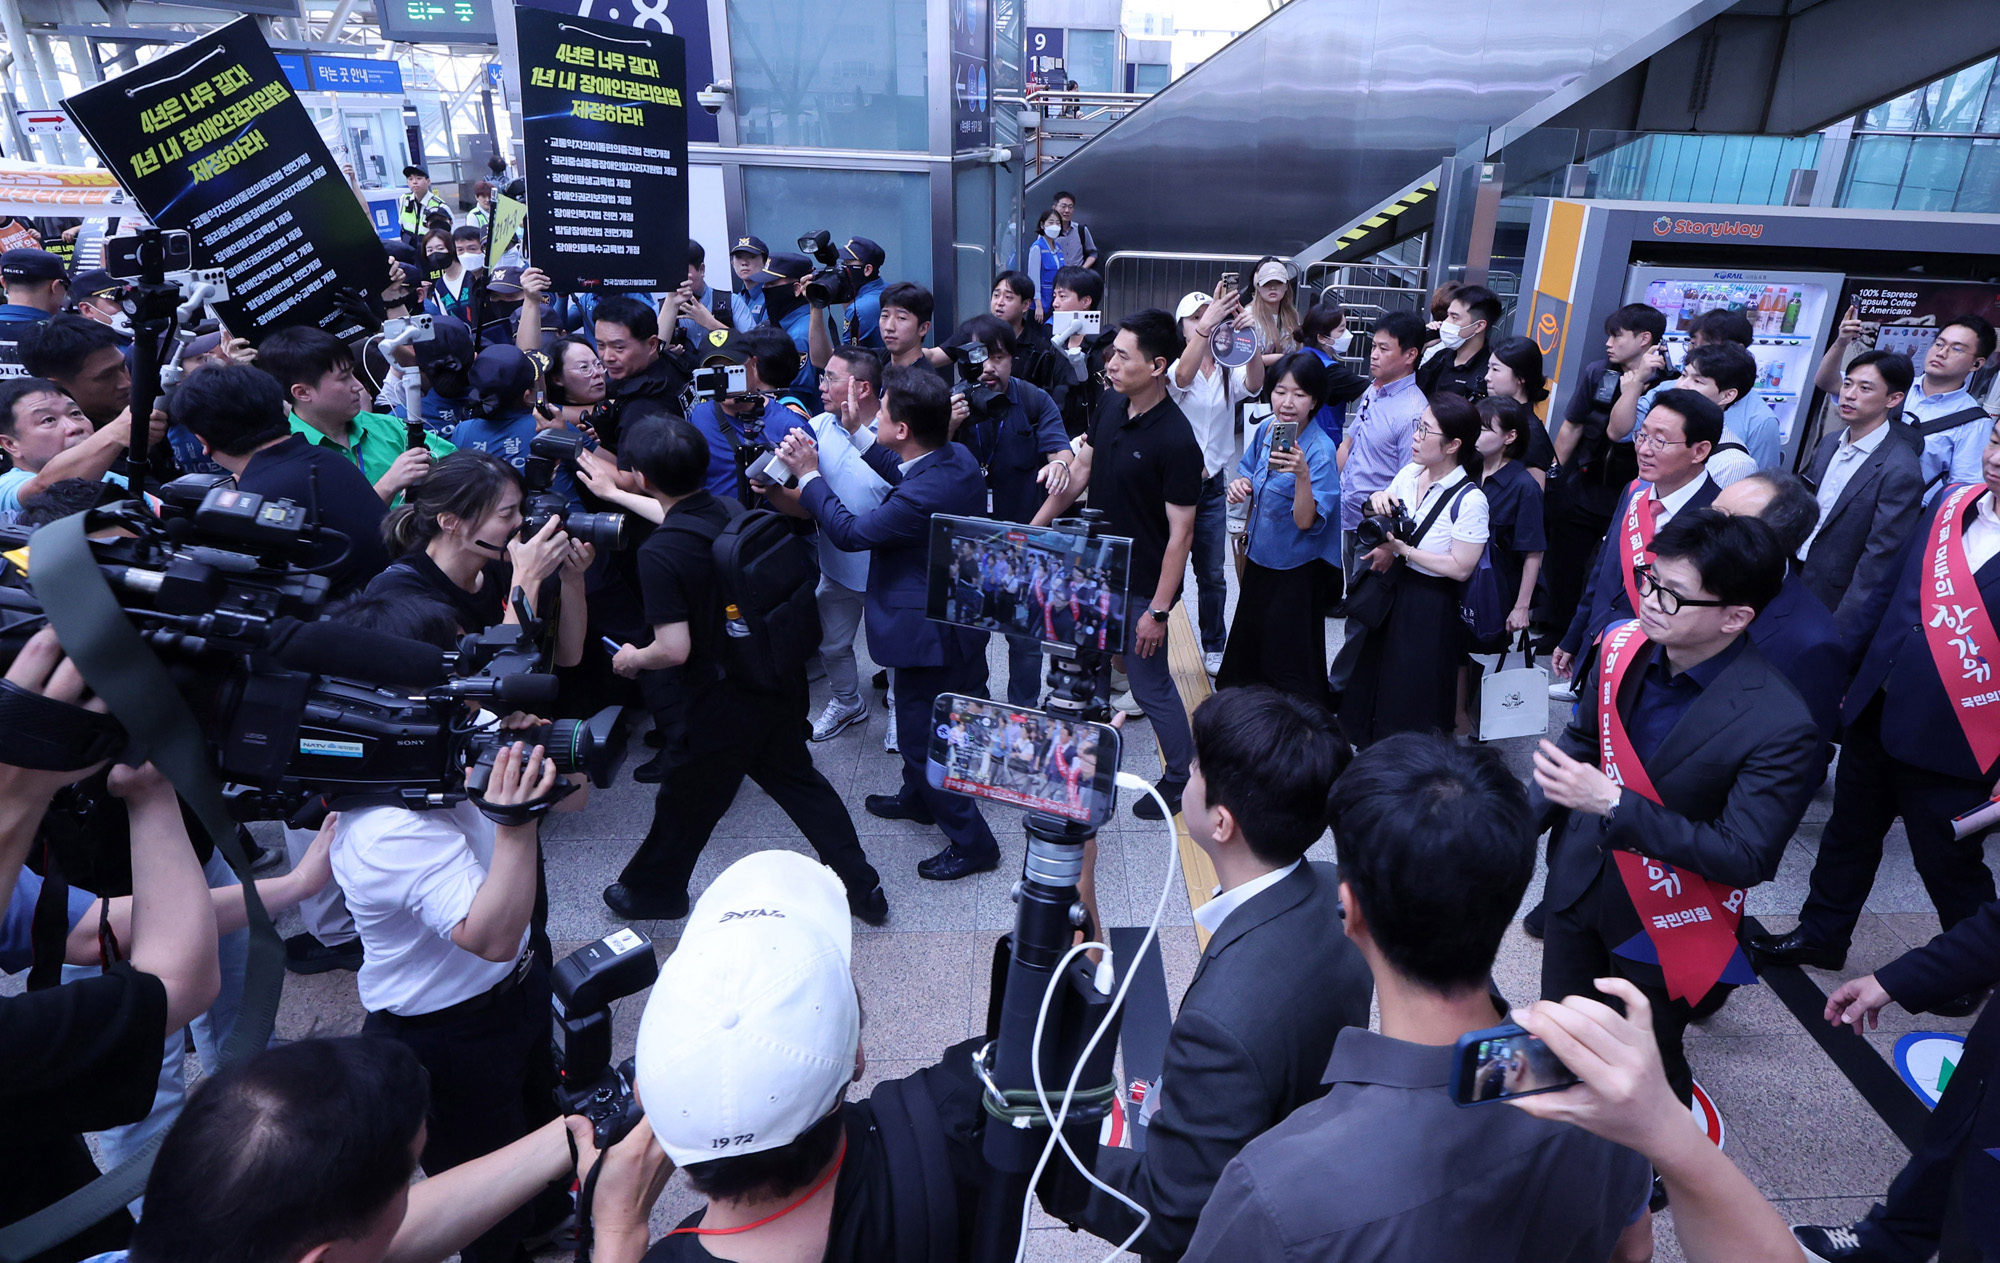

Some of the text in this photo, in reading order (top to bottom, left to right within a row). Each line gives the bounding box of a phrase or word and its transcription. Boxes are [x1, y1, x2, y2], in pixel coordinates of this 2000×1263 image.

[1034, 33, 1047, 51] 9
[555, 43, 660, 78] 4년은 너무 길다!
[319, 66, 338, 82] 타는
[340, 67, 350, 83] 곳
[350, 67, 369, 83] 안내
[140, 63, 254, 134] 4년은 너무 길다!
[530, 67, 683, 107] 1년 내 장애인권리입법
[570, 100, 645, 127] 제정하라!
[130, 146, 161, 179] 1년
[158, 136, 184, 164] 내
[179, 80, 291, 152] 장애인권리입법
[187, 128, 269, 186] 제정하라!
[550, 137, 671, 159] 교통약자의이동편의증진법 전면개정
[311, 165, 328, 180] 제정
[552, 173, 631, 189] 장애인평생교육법 제정
[663, 166, 678, 177] 제정
[190, 152, 312, 230] 교통약자의이동편의증진법 전면개정
[553, 191, 632, 205] 장애인권리보장법 제정
[554, 208, 634, 222] 장애인복지법 전면 개정
[213, 210, 294, 263] 장애인평생교육법 제정
[555, 225, 633, 238] 발달장애인법 전면개정
[224, 227, 303, 280] 장애인권리보장법 제정
[556, 243, 640, 255] 장애인등특수교육법 개정
[235, 241, 315, 296] 장애인복지법 전면 개정
[245, 258, 323, 311] 발달장애인법 전면개정
[1859, 288, 1918, 299] 100% Espresso
[256, 268, 338, 326] 장애인등특수교육법 개정
[1861, 299, 1917, 308] apsule Coffee
[1869, 306, 1912, 315] Americano
[1629, 531, 1644, 552] 힘
[1938, 524, 1951, 545] 힘
[1933, 544, 1955, 598] 모두의
[1928, 603, 1991, 684] 한가위
[1603, 681, 1612, 705] 힘
[1960, 690, 2000, 708] 국민의
[396, 739, 425, 747] SONY
[1602, 713, 1625, 787] 모두의
[1652, 906, 1713, 930] 국민의힘
